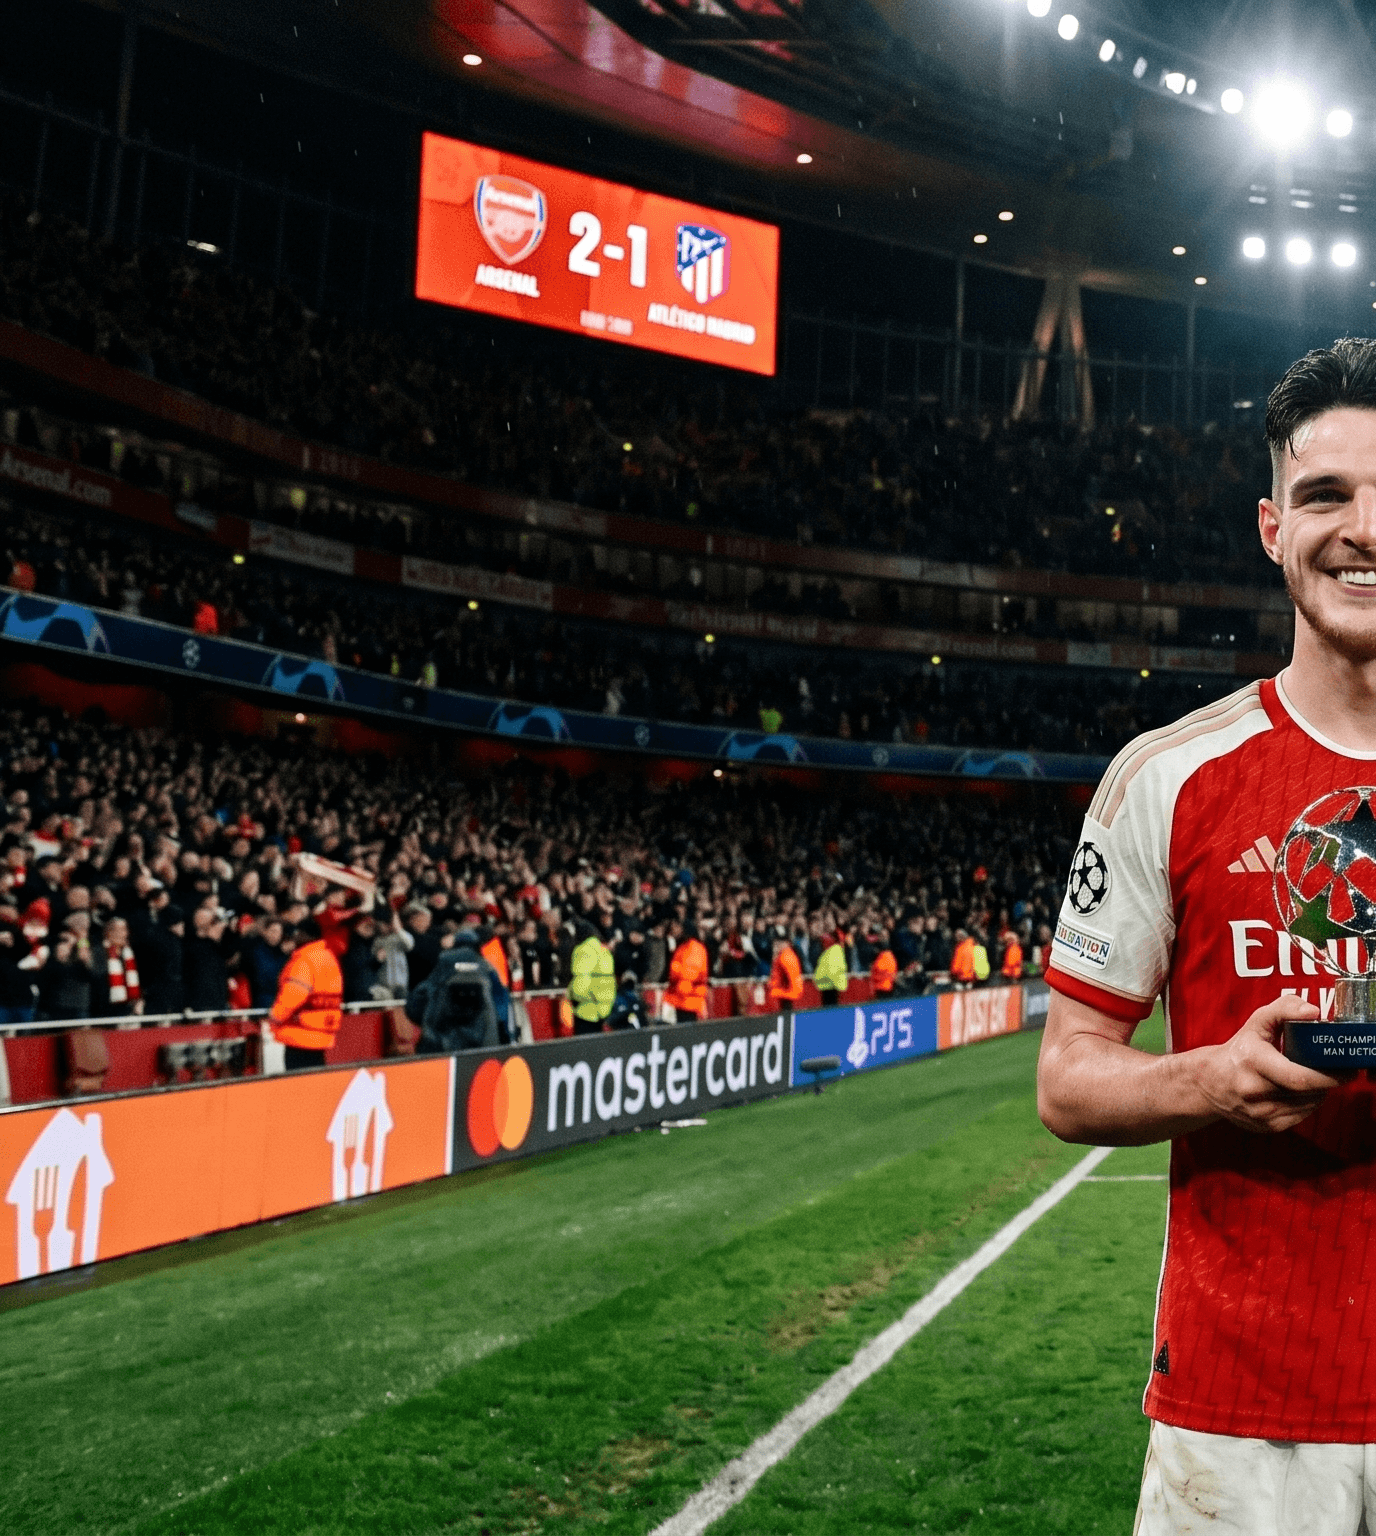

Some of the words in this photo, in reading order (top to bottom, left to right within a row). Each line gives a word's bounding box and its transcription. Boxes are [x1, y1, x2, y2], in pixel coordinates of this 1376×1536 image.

[568, 210, 648, 289] 2-1
[1312, 1035, 1335, 1044] UEFA
[1323, 1047, 1345, 1056] MAN
[547, 1014, 785, 1132] mastercard
